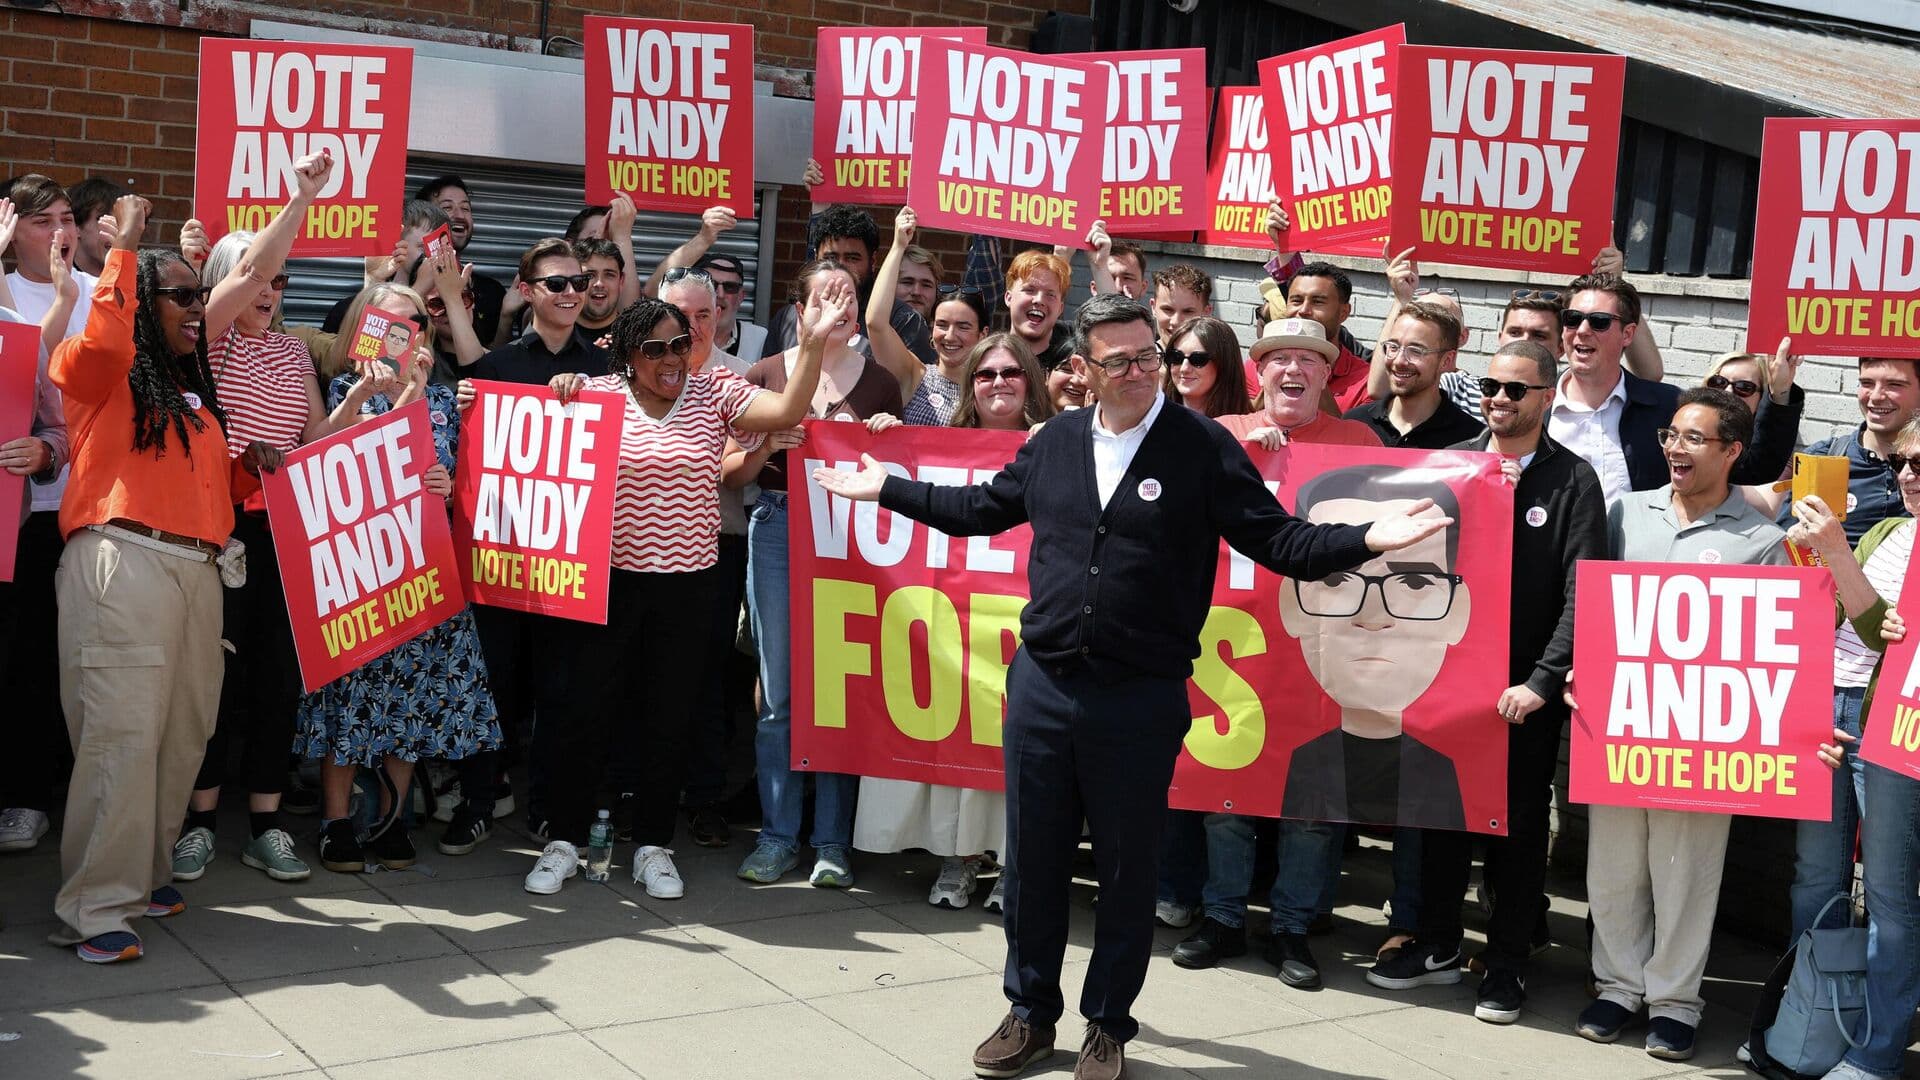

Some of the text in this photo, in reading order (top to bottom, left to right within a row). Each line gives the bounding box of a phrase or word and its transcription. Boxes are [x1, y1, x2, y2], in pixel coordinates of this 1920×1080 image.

[231, 51, 387, 129] VOTE
[606, 27, 731, 100] VOTE
[839, 36, 955, 97] VOT
[947, 49, 1086, 133] VOTE
[1277, 40, 1393, 132] VOTE
[607, 97, 729, 162] ANDY
[835, 99, 917, 154] AND
[1229, 95, 1269, 151] VO
[1427, 58, 1594, 142] VOTE
[227, 131, 381, 199] ANDY
[607, 160, 731, 199] VOTE HOPE
[835, 159, 892, 187] VOTE
[938, 117, 1080, 193] ANDY
[1290, 113, 1392, 197] ANDY
[1420, 137, 1586, 213] ANDY
[1799, 129, 1920, 214] VOT
[306, 205, 379, 239] HOPE
[937, 180, 1004, 220] VOTE
[1009, 192, 1078, 231] HOPE
[1119, 185, 1183, 217] HOPE
[1214, 205, 1251, 233] VOTE
[1294, 193, 1348, 233] VOTE
[1350, 184, 1392, 223] HOP
[1420, 208, 1582, 256] VOTE HOPE
[1787, 217, 1920, 292] AND
[359, 334, 382, 350] VOTE
[361, 323, 386, 339] ANDY
[366, 313, 390, 330] VOTE
[1786, 296, 1920, 338] VOTE HO
[355, 344, 379, 360] HOPE
[482, 393, 603, 481] VOTE
[287, 416, 421, 541] VOTE
[472, 472, 592, 555] ANDY
[309, 495, 426, 618] ANDY
[471, 547, 587, 600] VOTE HOPE
[320, 600, 384, 659] VOTE
[384, 567, 445, 628] HOPE
[1610, 573, 1801, 664] VOTE
[1606, 661, 1797, 746] ANDY
[1890, 704, 1920, 752] VO
[1605, 743, 1798, 796] VOTE HOPE
